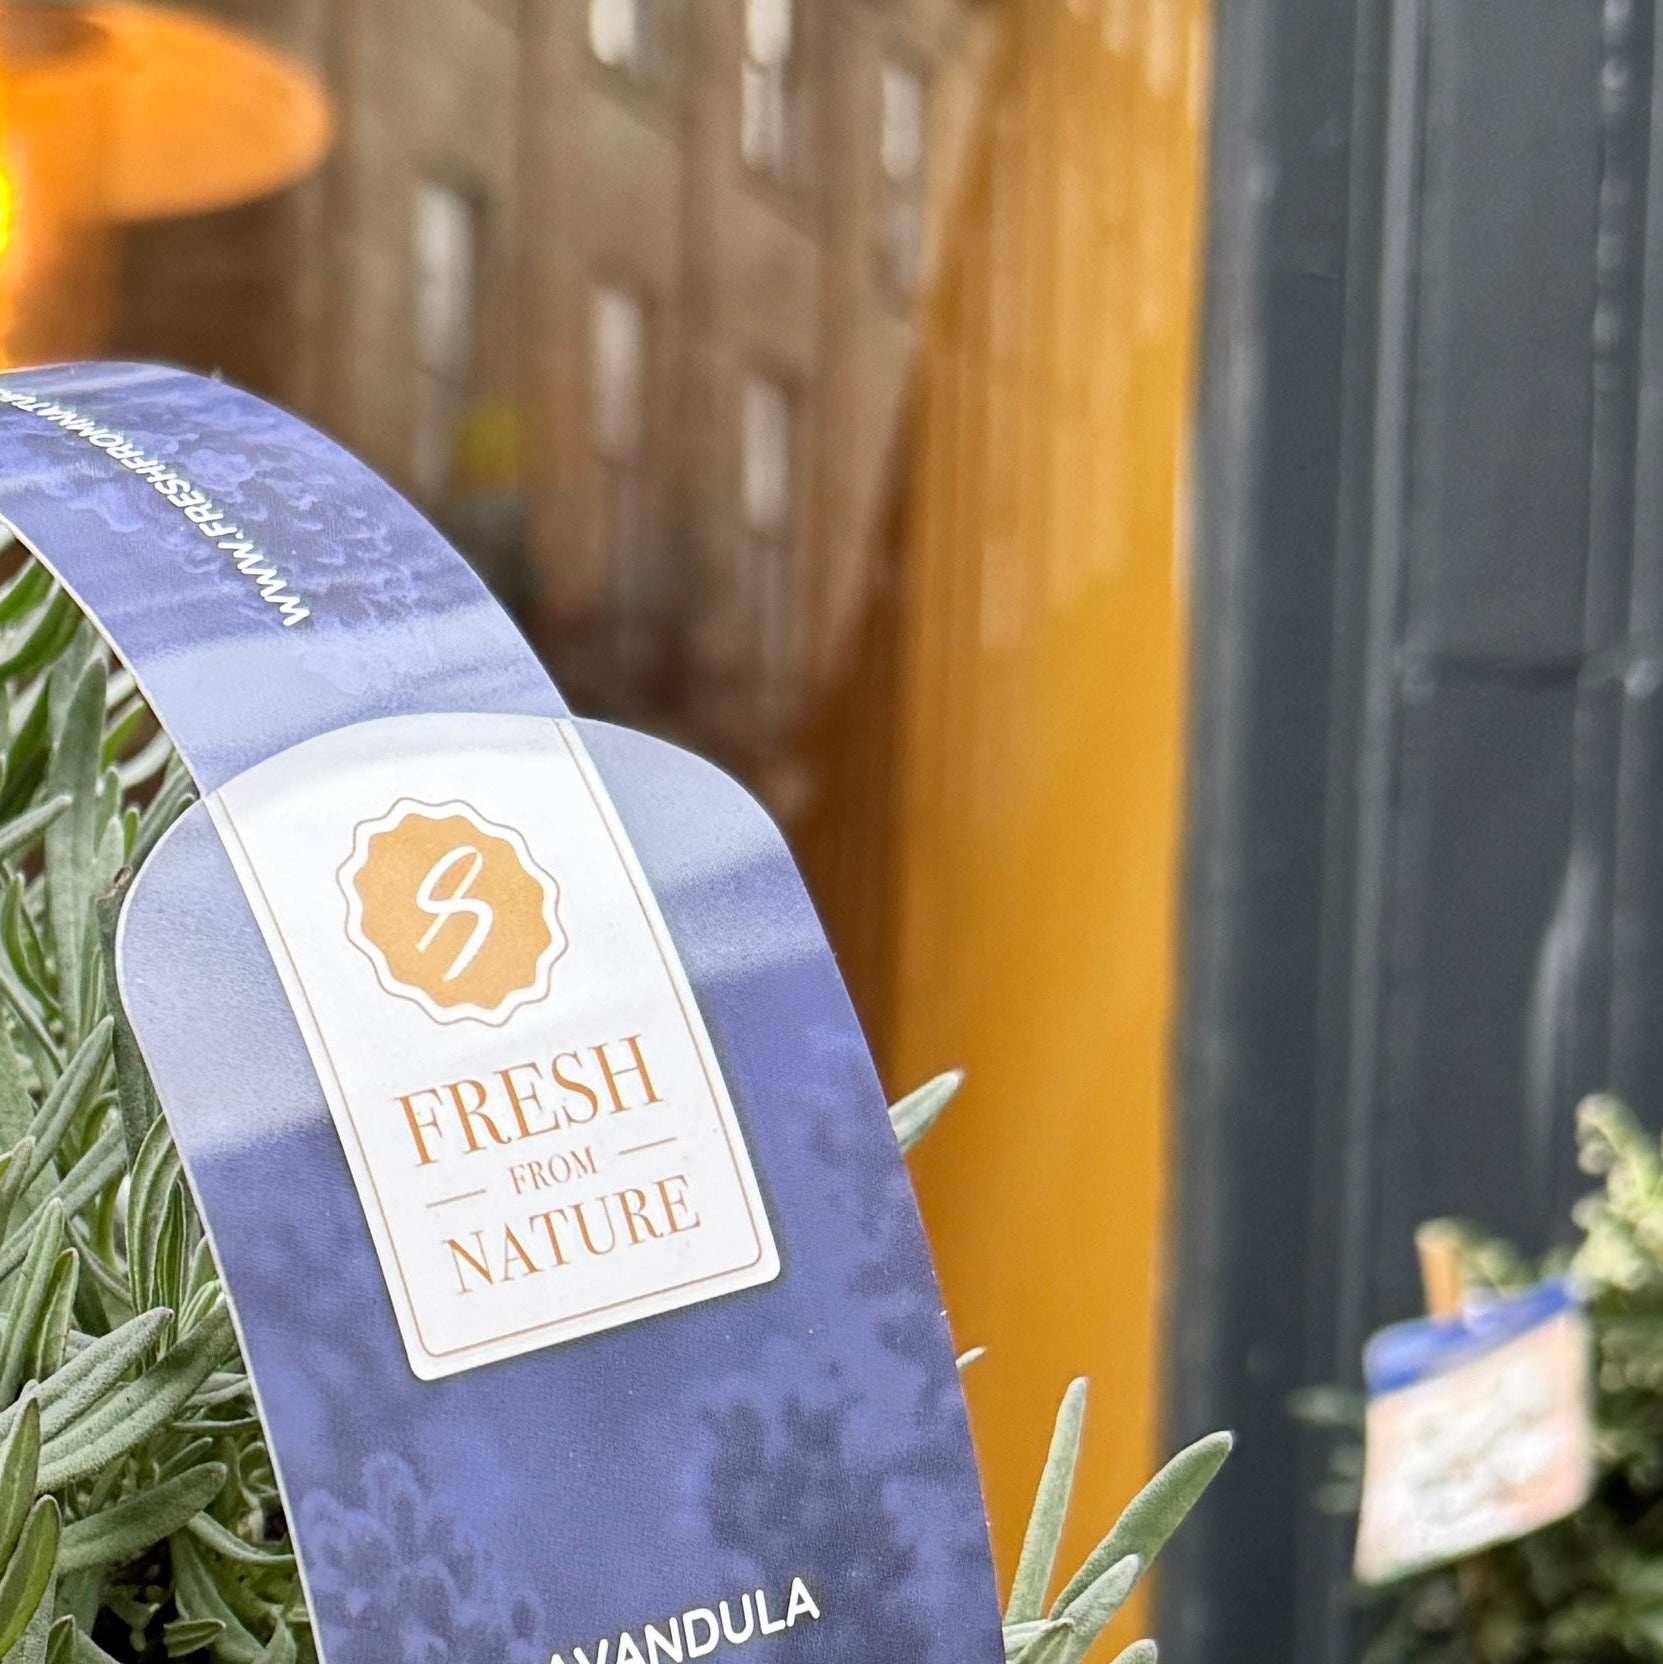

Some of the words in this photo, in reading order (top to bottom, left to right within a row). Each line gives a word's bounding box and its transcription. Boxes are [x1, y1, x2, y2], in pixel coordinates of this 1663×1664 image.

[393, 1034, 664, 1167] FRESH
[508, 1147, 599, 1196] FROM
[442, 1174, 702, 1295] NATURE
